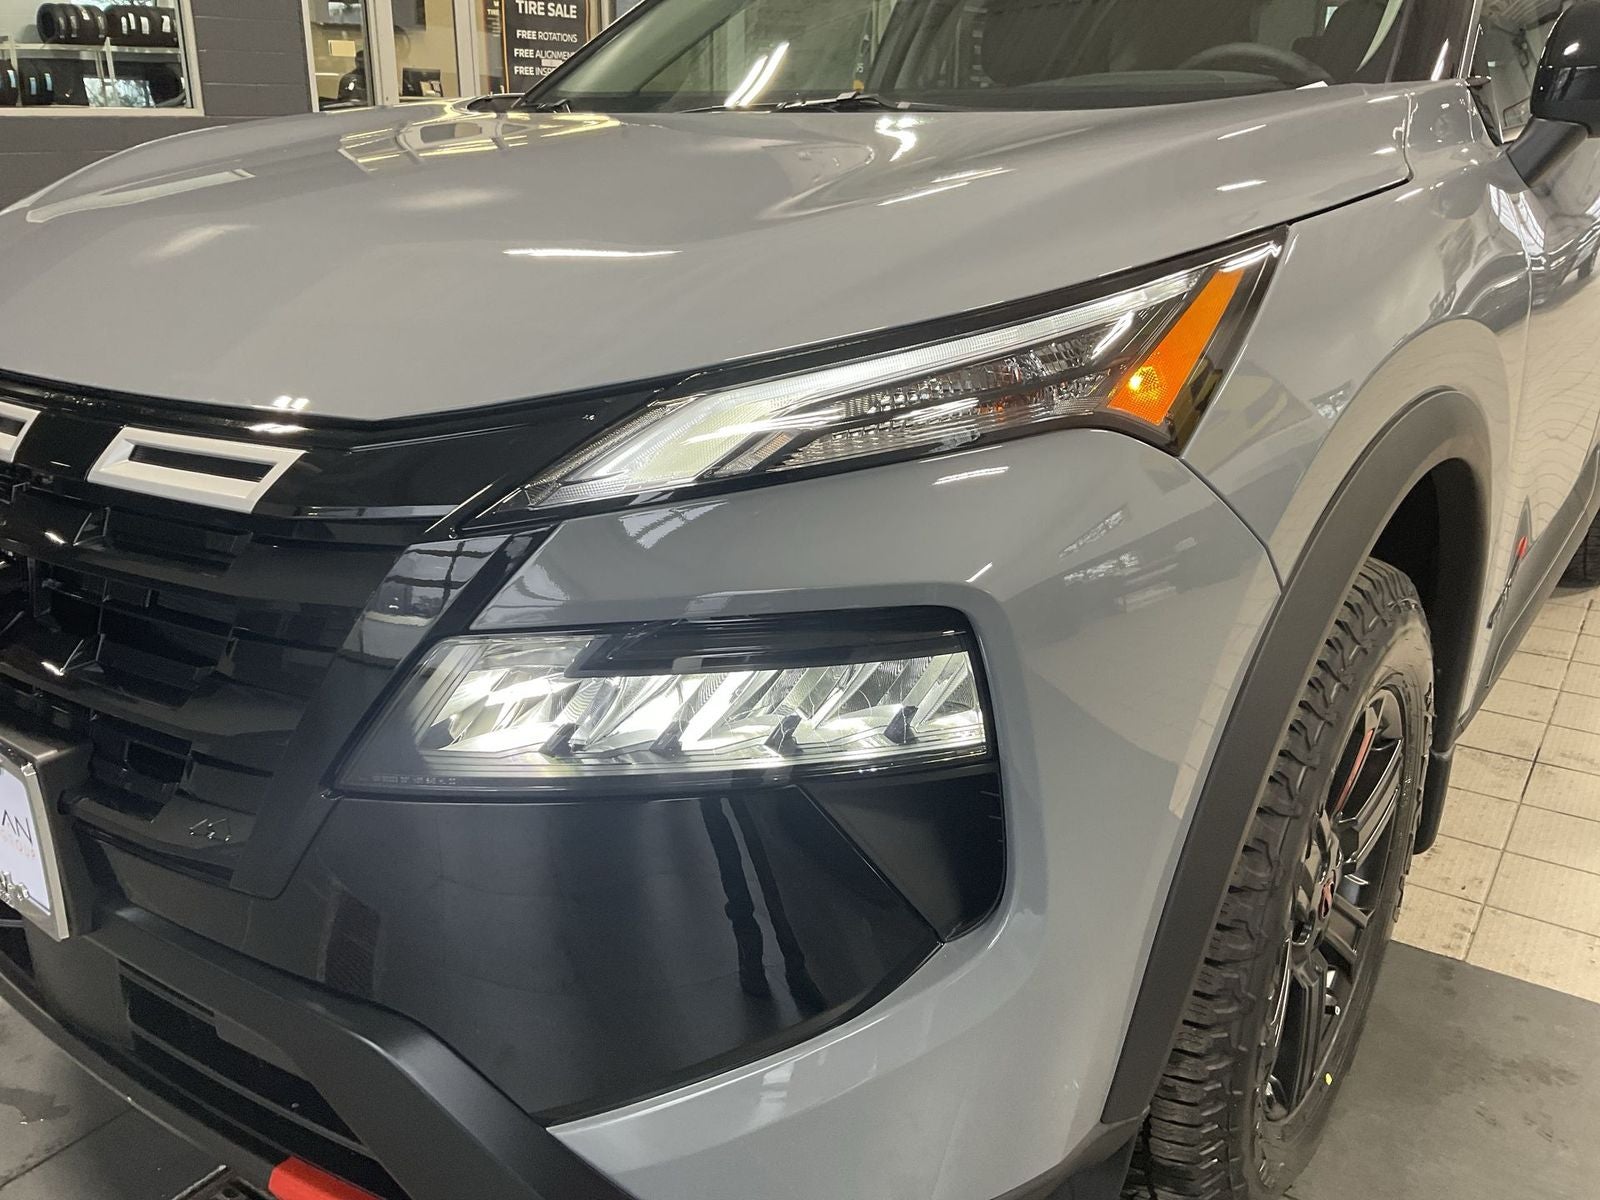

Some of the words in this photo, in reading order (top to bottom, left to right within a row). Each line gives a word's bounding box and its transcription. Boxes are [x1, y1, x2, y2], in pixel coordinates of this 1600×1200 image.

[515, 0, 545, 16] TIRE
[547, 2, 577, 19] SALE
[516, 29, 537, 40] FREE
[538, 31, 578, 43] ROTATIONS
[513, 47, 535, 58] FREE
[535, 49, 575, 60] ALIGNMEN
[513, 65, 535, 76] FREE
